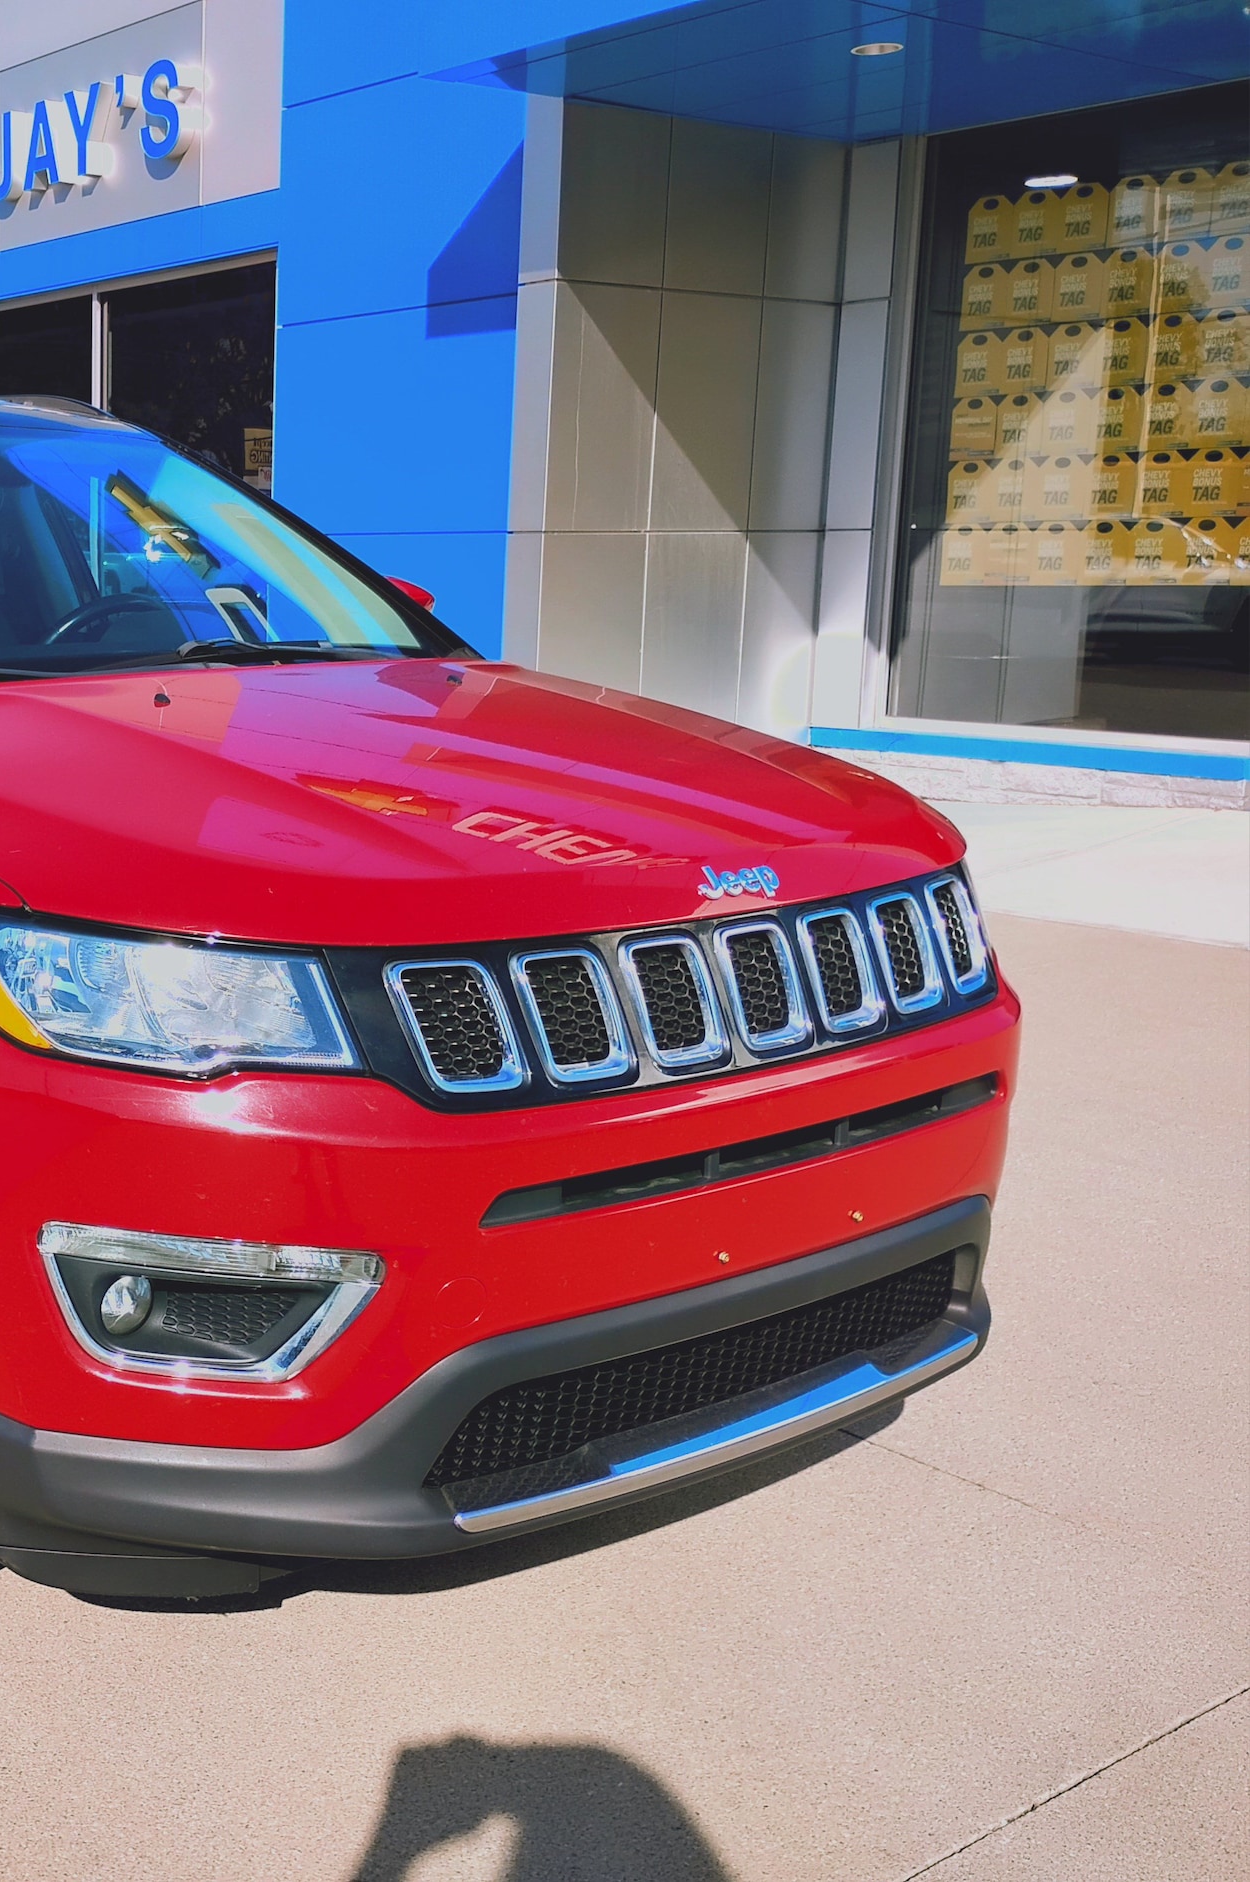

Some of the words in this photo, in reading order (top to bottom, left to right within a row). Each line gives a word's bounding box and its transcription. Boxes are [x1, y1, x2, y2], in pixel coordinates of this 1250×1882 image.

[1018, 226, 1043, 243] TAG
[1064, 221, 1090, 238] TAG
[973, 232, 997, 249] TAG
[1162, 281, 1188, 297] TAG
[1212, 274, 1240, 291] TAG
[1059, 290, 1085, 307] TAG
[1108, 285, 1135, 302] TAG
[967, 300, 991, 316] TAG
[1013, 296, 1037, 312] TAG
[1154, 351, 1180, 367] TAG
[1205, 346, 1233, 363] TAG
[1054, 360, 1079, 376] TAG
[1103, 355, 1128, 371] TAG
[962, 367, 986, 383] TAG
[1006, 364, 1031, 379] TAG
[1097, 423, 1122, 439] TAG
[1148, 420, 1173, 435] TAG
[1198, 417, 1226, 433] TAG
[1193, 468, 1224, 479] CHEVY
[1192, 477, 1223, 487] BONUS
[1091, 489, 1118, 504] TAG
[1142, 487, 1169, 503] TAG
[1192, 486, 1221, 502] TAG
[1085, 556, 1111, 571] TAG
[1135, 555, 1161, 570] TAG
[697, 865, 780, 900] Jeep
